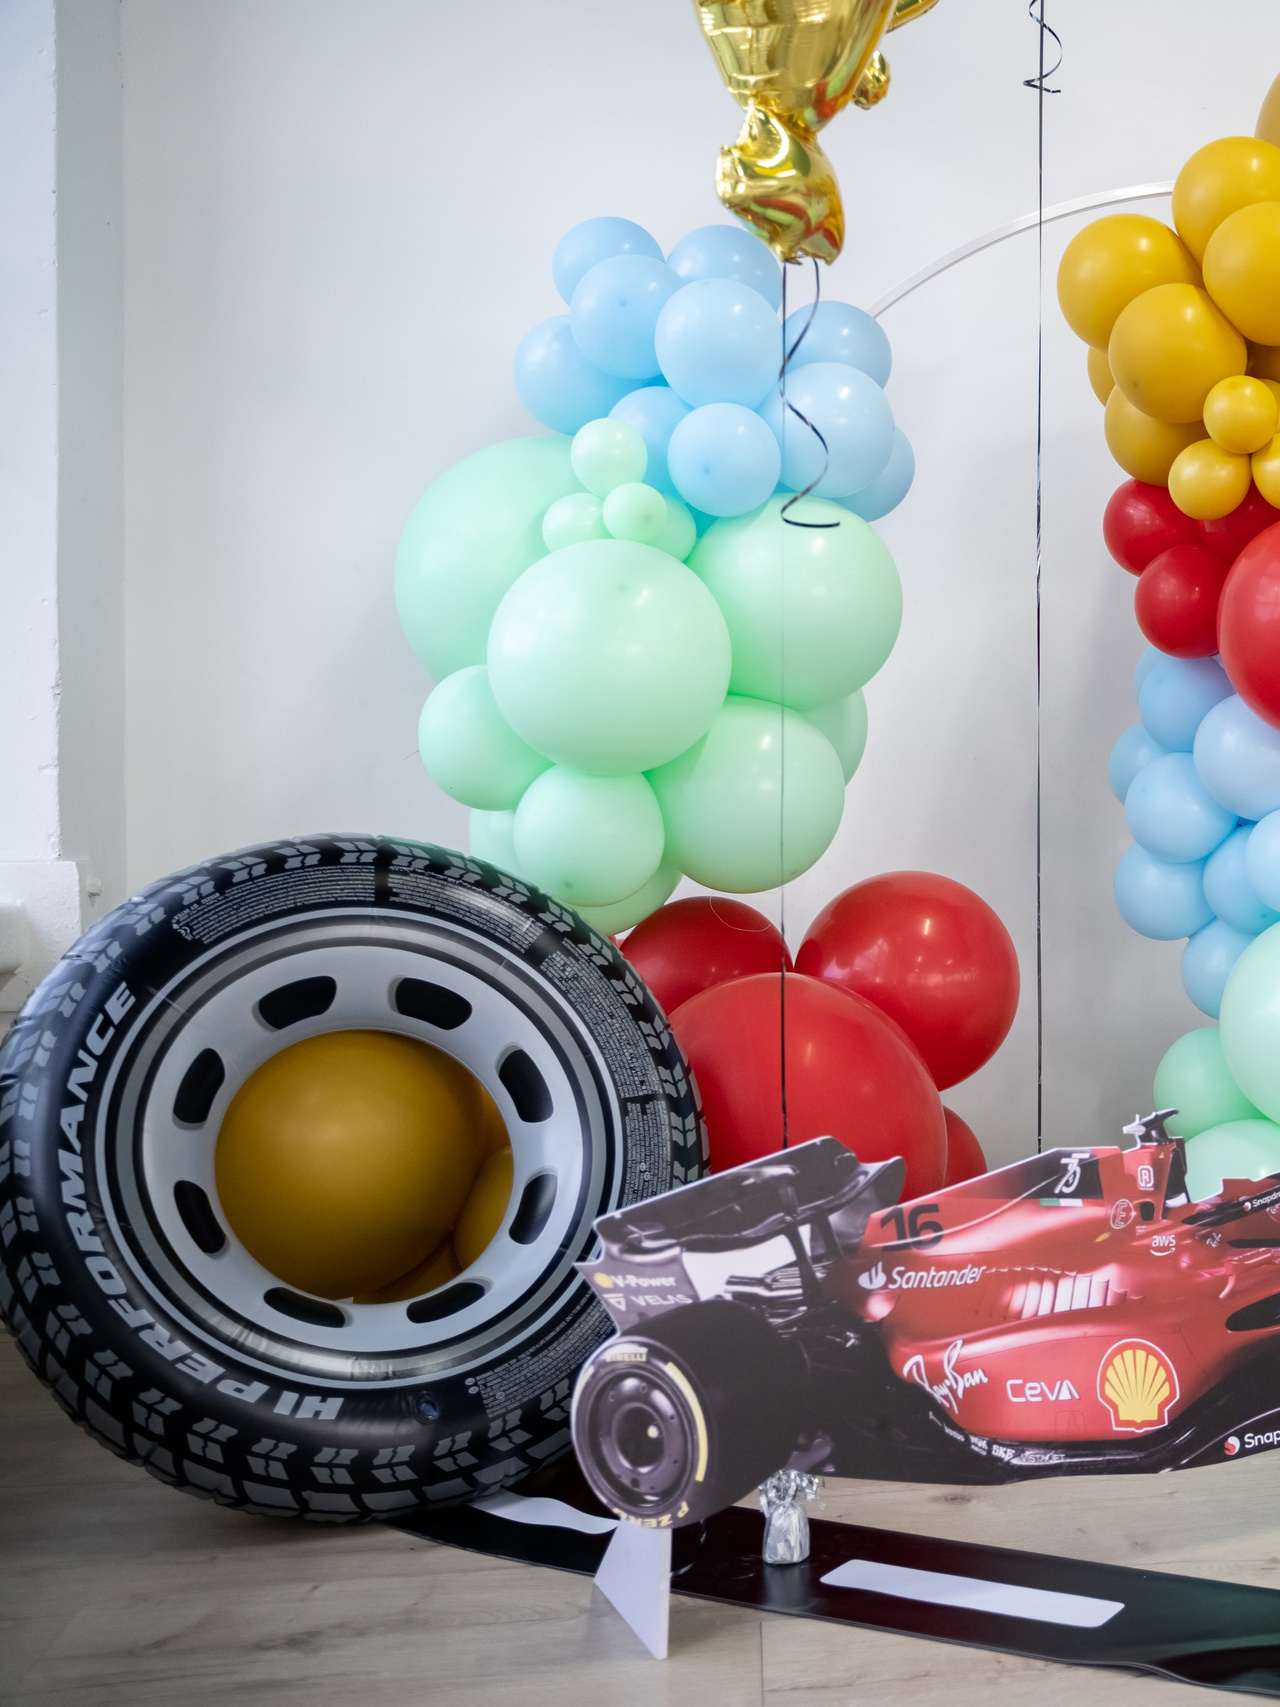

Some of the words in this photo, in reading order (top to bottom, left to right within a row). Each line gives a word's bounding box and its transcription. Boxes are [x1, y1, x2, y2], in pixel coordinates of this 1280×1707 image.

[58, 981, 271, 1404] PERFORMANCE
[880, 1203, 944, 1251] 16
[1152, 1235, 1176, 1247] aws
[888, 1264, 987, 1289] Santander
[630, 1294, 693, 1306] VELAS
[273, 1390, 345, 1420] HI
